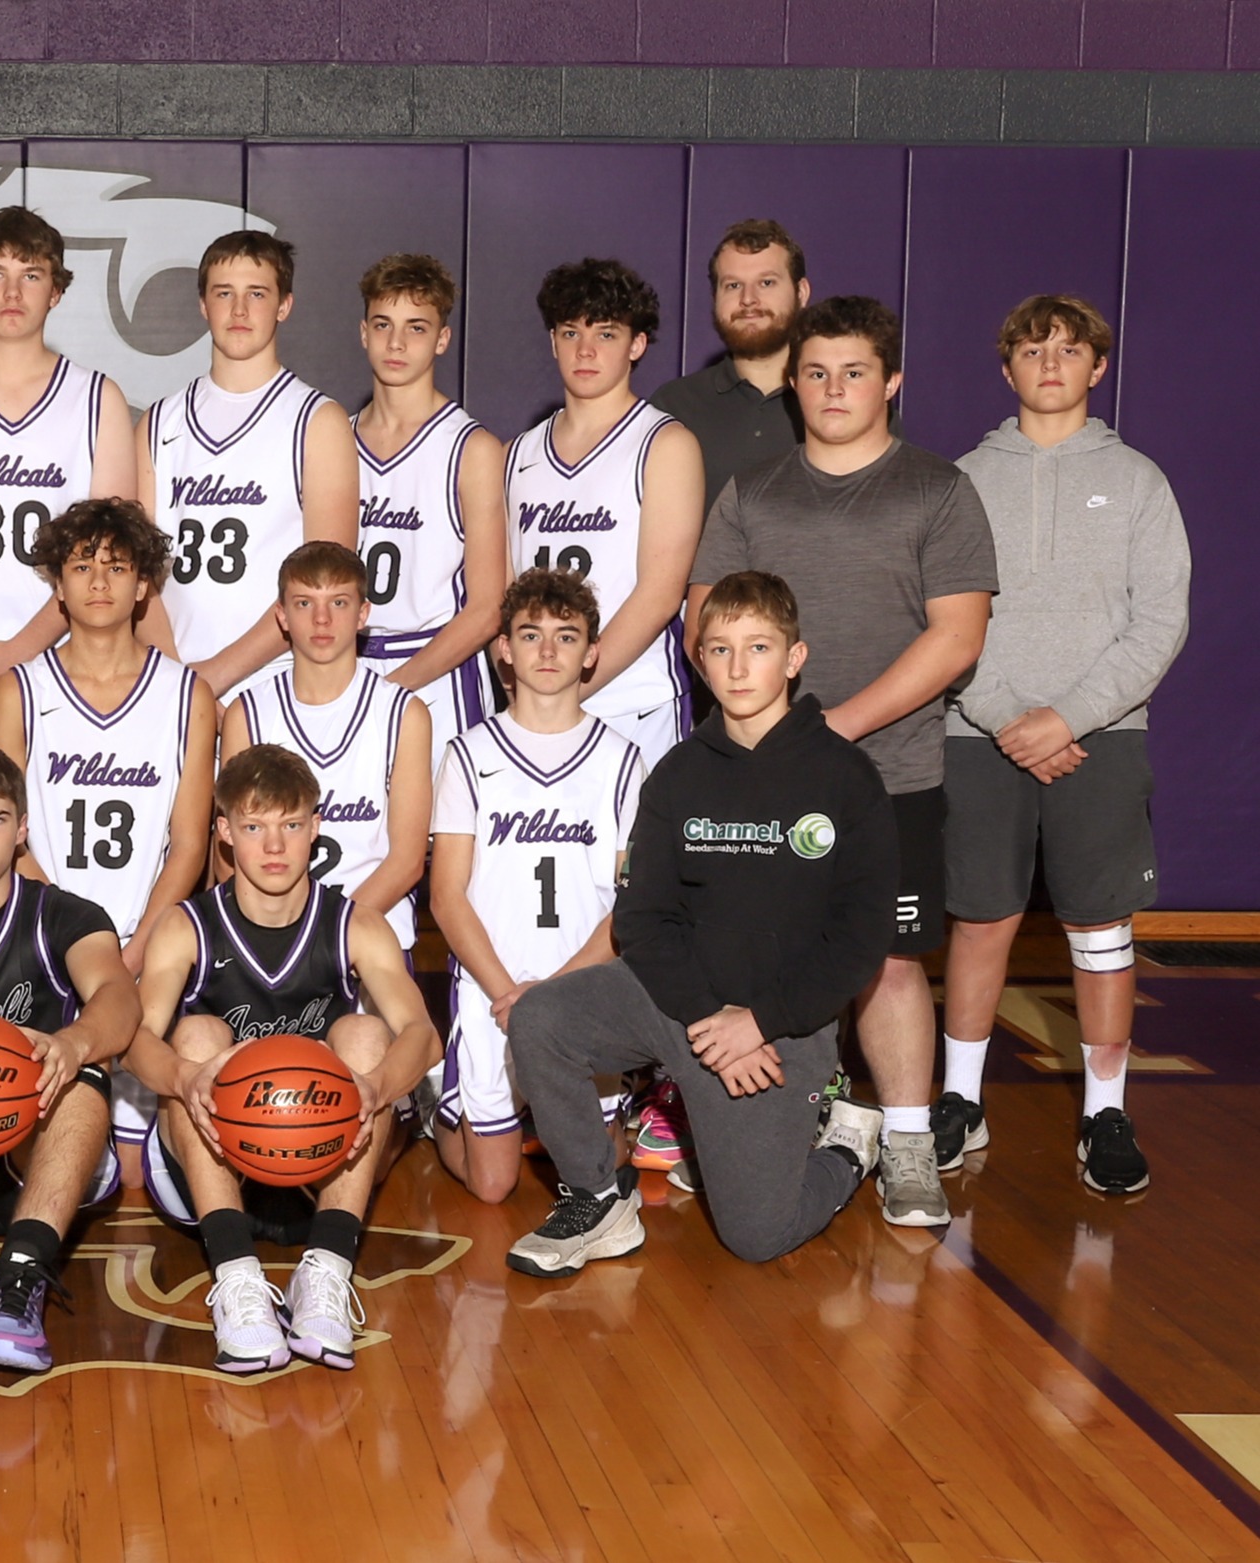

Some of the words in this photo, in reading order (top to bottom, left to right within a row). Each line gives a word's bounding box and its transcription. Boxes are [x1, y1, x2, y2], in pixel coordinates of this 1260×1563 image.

[169, 474, 267, 509] Wildcats
[359, 496, 424, 531] ildcats
[519, 500, 617, 534] Wildcats
[172, 517, 249, 585] 33
[47, 752, 161, 787] Wildcats
[66, 799, 136, 870] 13
[488, 808, 597, 847] Wildcats
[534, 856, 560, 928] 1
[243, 1080, 342, 1109] Baden
